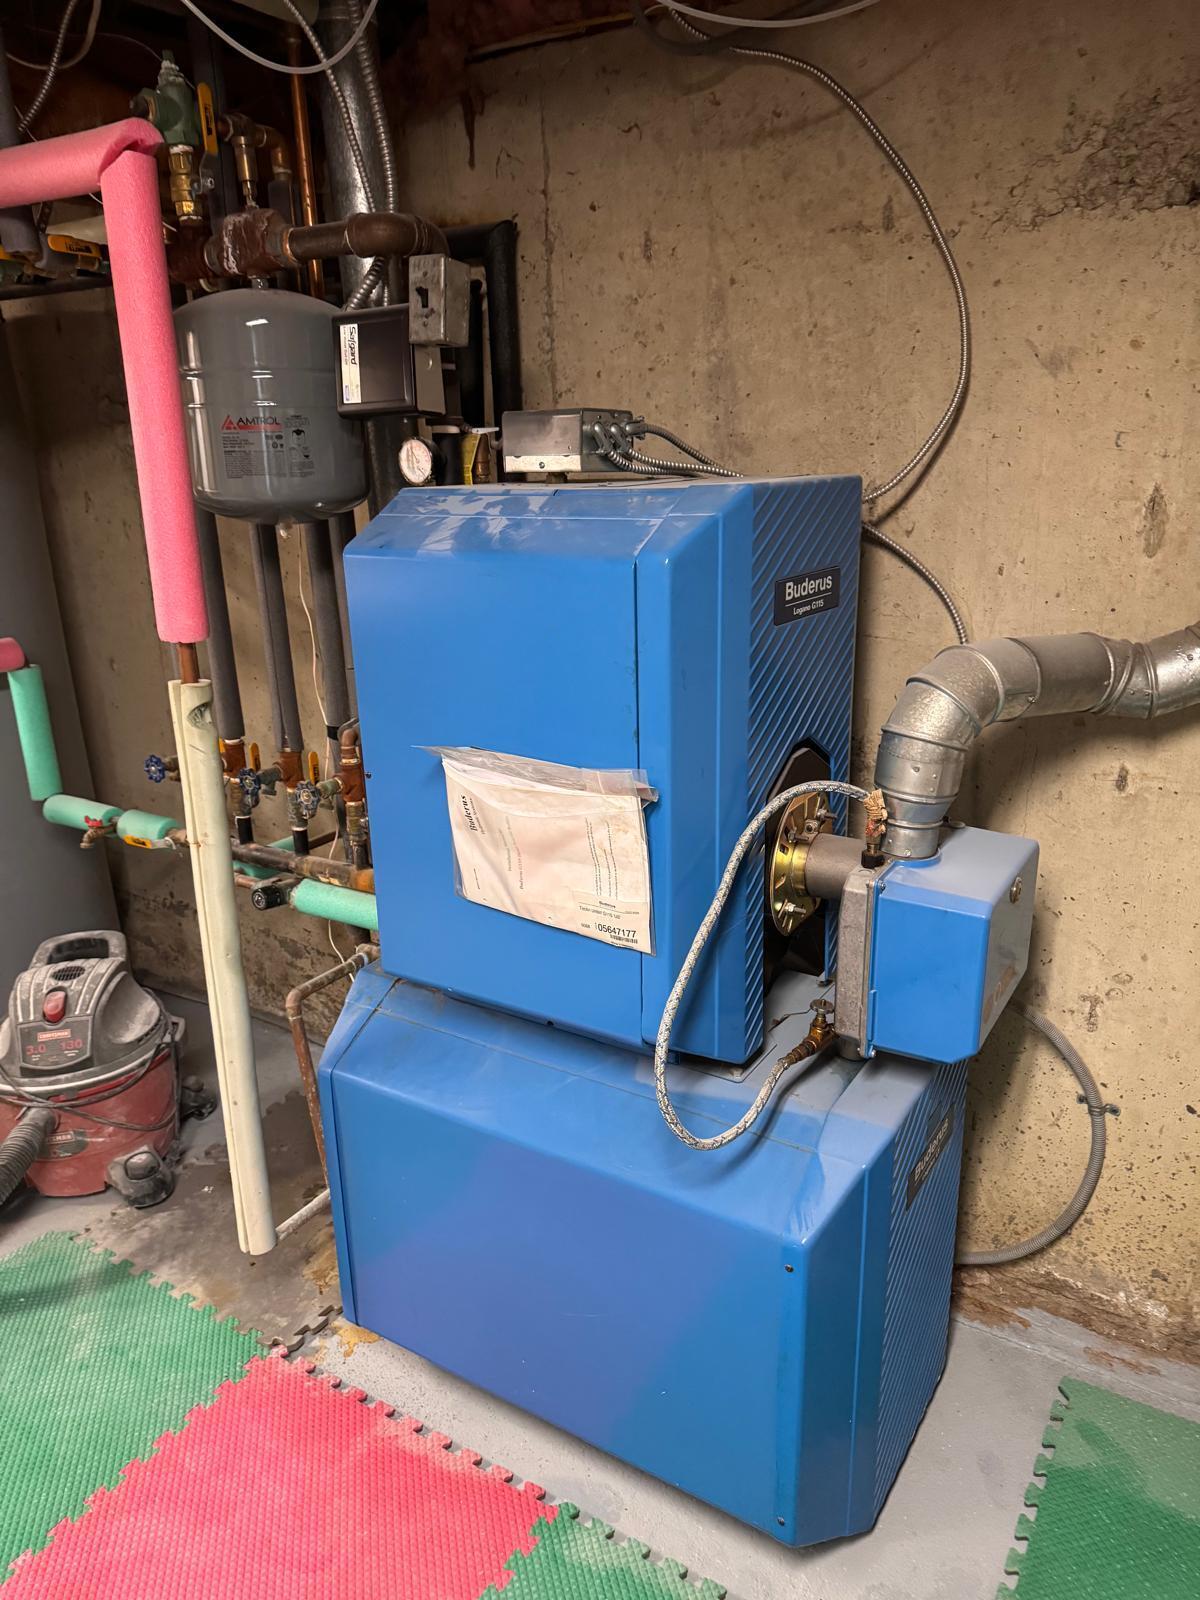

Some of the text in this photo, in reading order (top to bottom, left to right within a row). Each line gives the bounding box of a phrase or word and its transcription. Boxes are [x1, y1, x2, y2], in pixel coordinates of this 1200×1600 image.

[348, 326, 358, 366] Safgard
[237, 416, 281, 425] AMTROL
[785, 576, 833, 601] Buderus
[793, 599, 825, 616] Logano G115
[460, 794, 478, 832] Buderus
[597, 922, 637, 938] 05647177
[26, 1039, 83, 1055] 3.0 130
